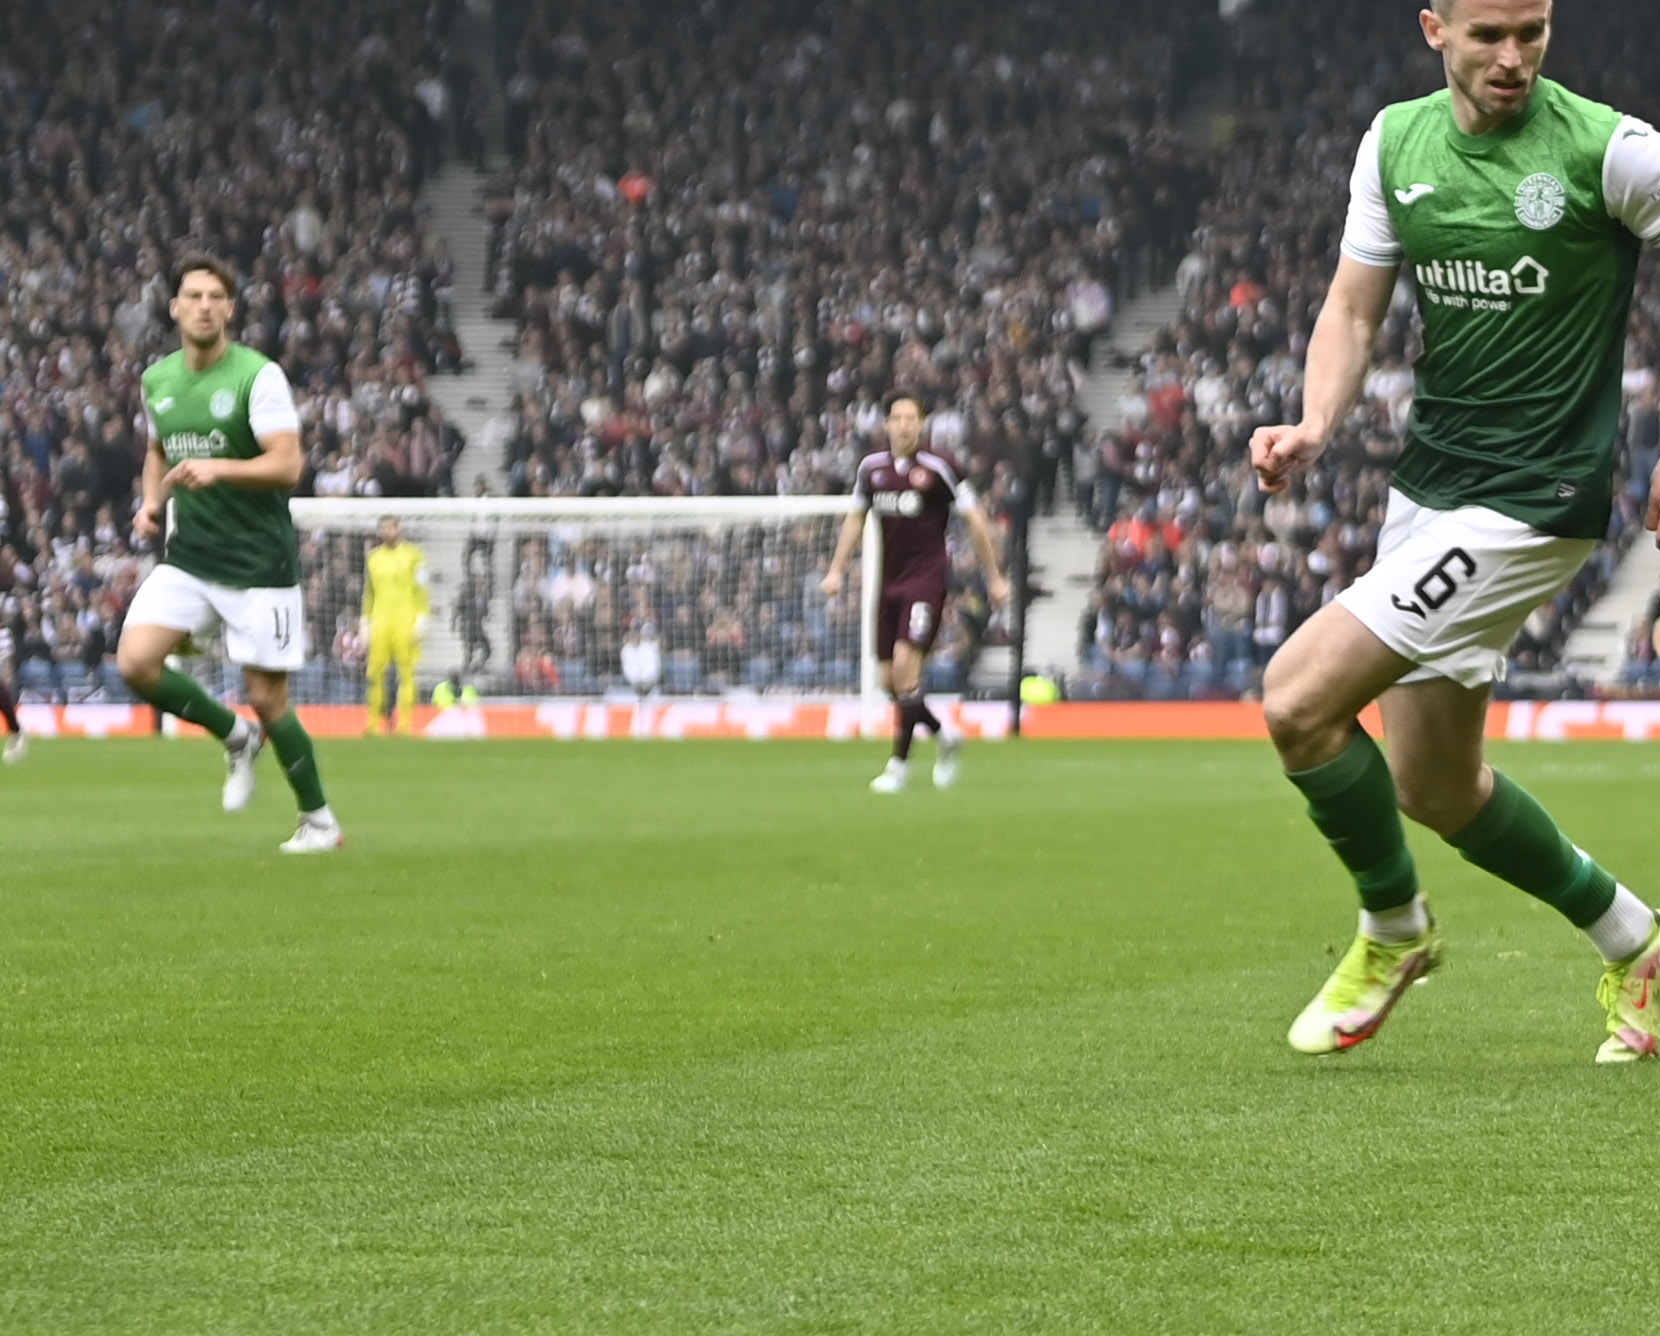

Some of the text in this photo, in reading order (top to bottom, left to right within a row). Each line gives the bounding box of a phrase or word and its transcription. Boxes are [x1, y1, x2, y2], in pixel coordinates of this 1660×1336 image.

[1415, 258, 1511, 295] utilita
[1471, 297, 1512, 312] power
[1413, 547, 1477, 611] 6
